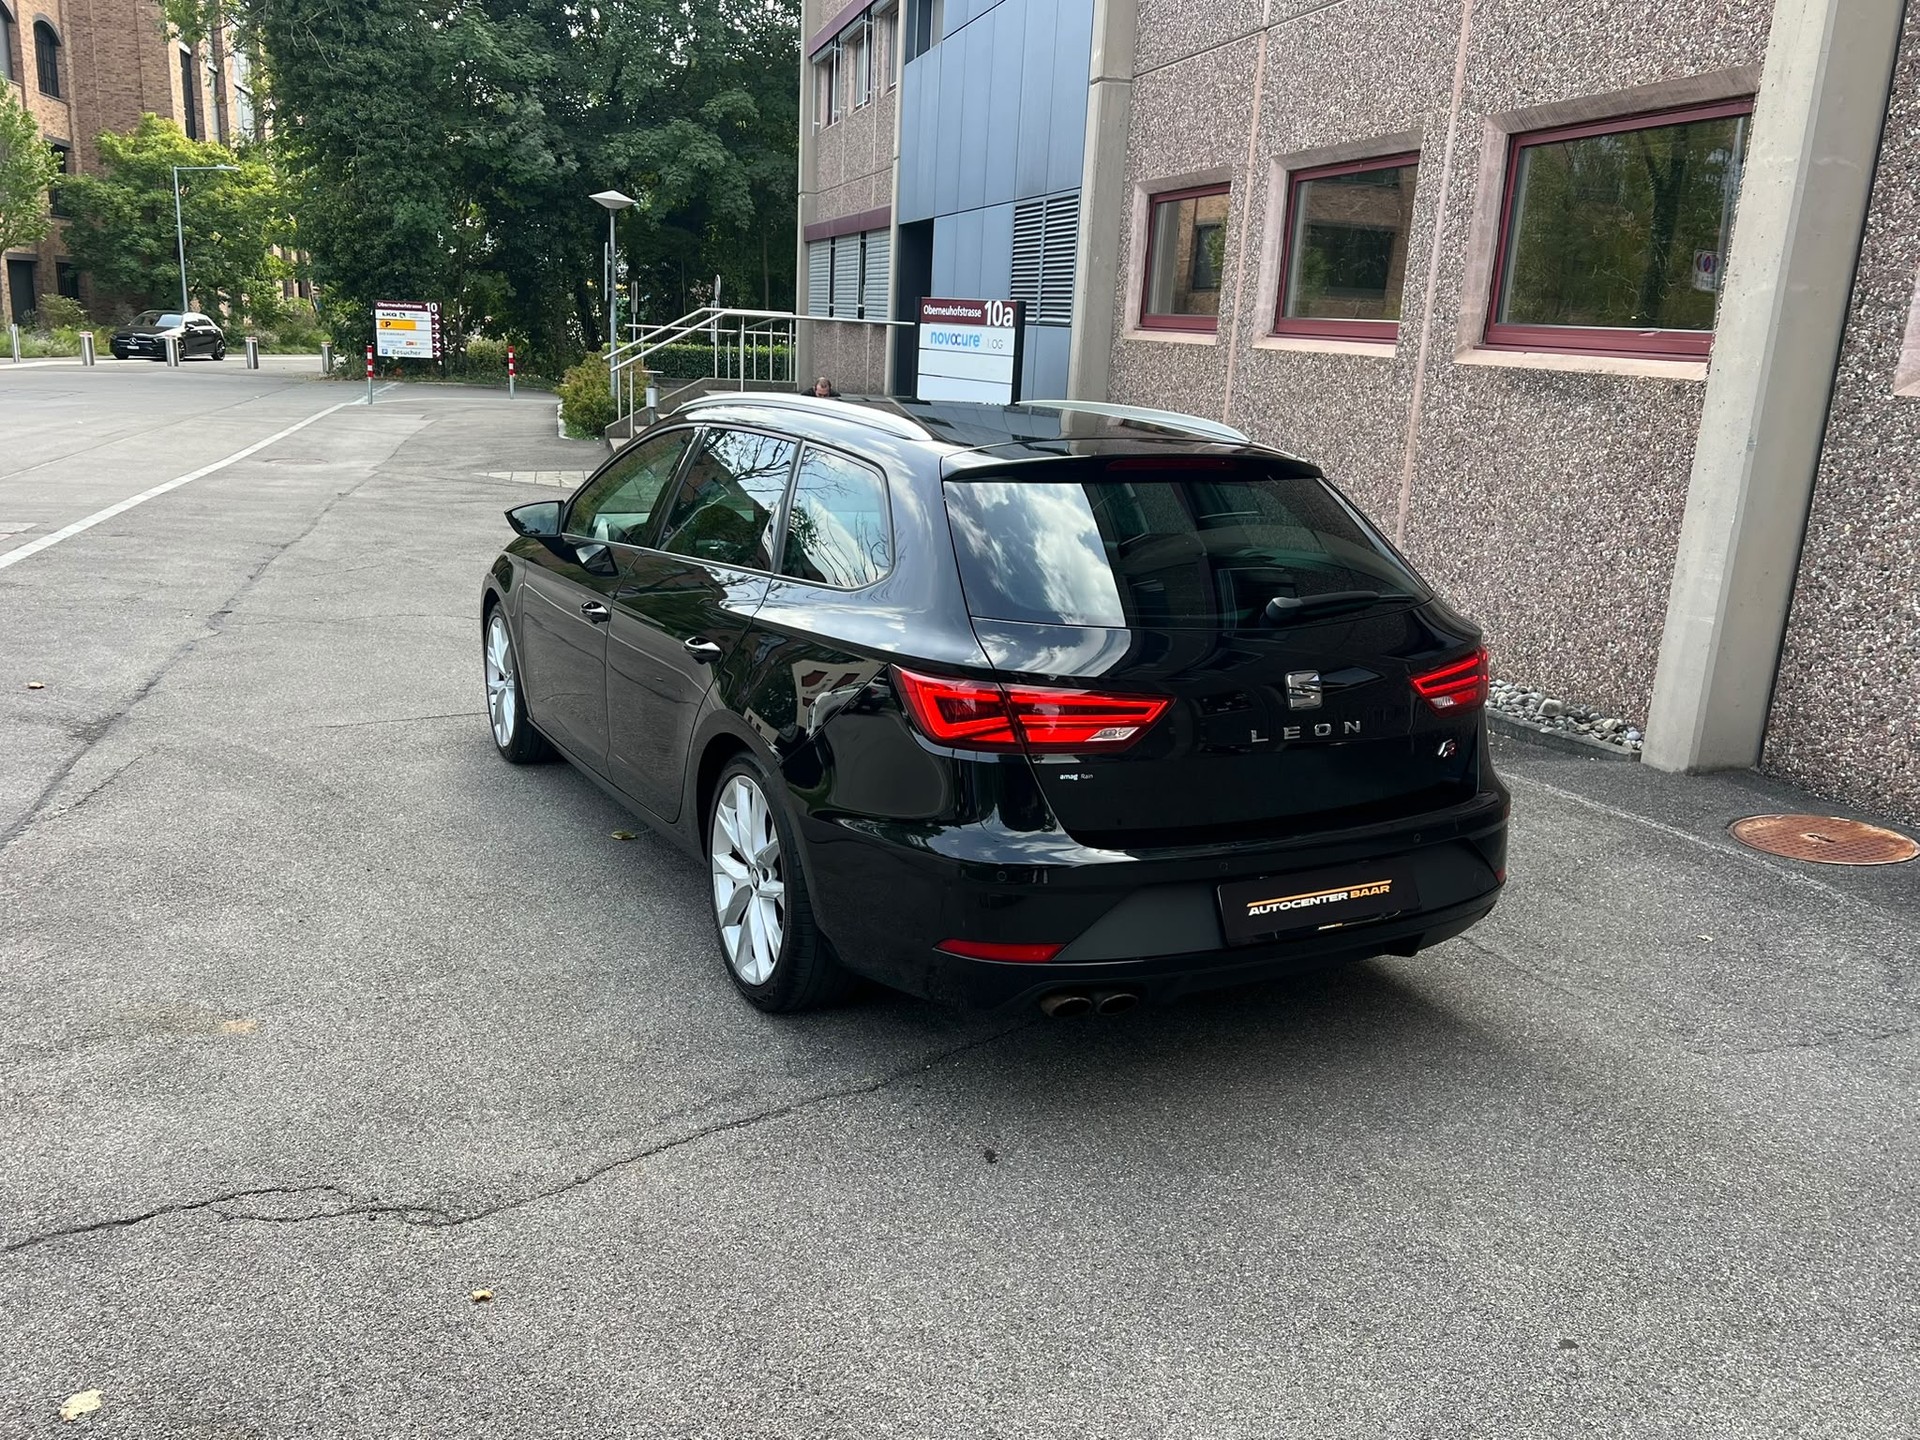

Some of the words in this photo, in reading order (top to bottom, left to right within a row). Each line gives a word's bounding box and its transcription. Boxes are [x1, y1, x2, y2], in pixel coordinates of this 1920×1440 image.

[425, 302, 438, 312] 10
[923, 305, 982, 318] Oberneuhofstrasse
[984, 300, 1014, 327] 10a
[930, 331, 981, 347] novocure
[1250, 720, 1361, 743] LEON
[1248, 892, 1348, 916] AUTOCENTER
[1350, 885, 1390, 899] BAAR
